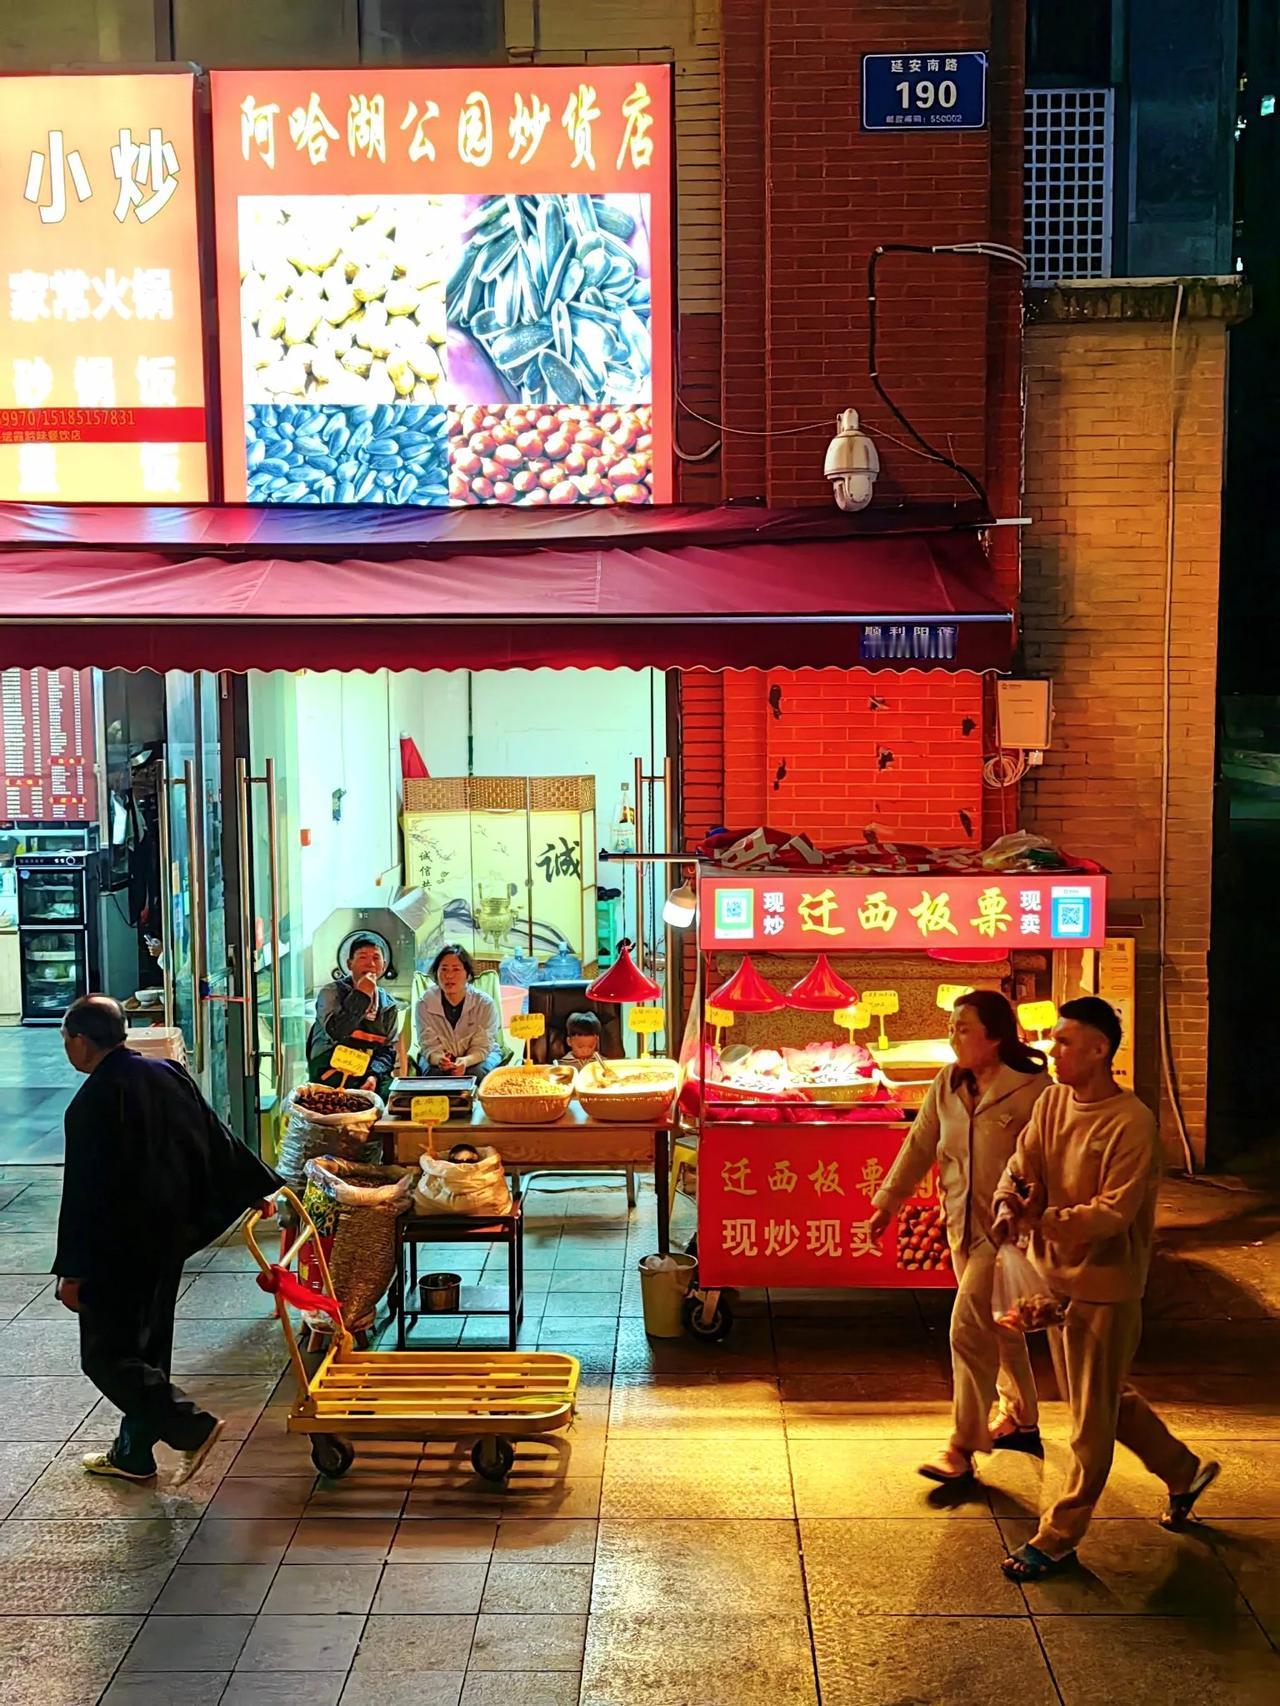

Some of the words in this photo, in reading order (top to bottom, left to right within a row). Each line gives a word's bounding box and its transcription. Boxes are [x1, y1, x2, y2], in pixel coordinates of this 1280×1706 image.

[890, 58, 958, 73] 延安南路
[896, 80, 957, 109] 190
[24, 128, 181, 224] 小炒
[0, 409, 136, 426] 9970/15185157831
[762, 891, 785, 936] 现炒
[798, 886, 1014, 939] 迁西板栗
[1019, 889, 1043, 936] 现卖
[721, 1157, 885, 1197] 迁西板栗
[721, 1219, 883, 1257] 现炒现卖
